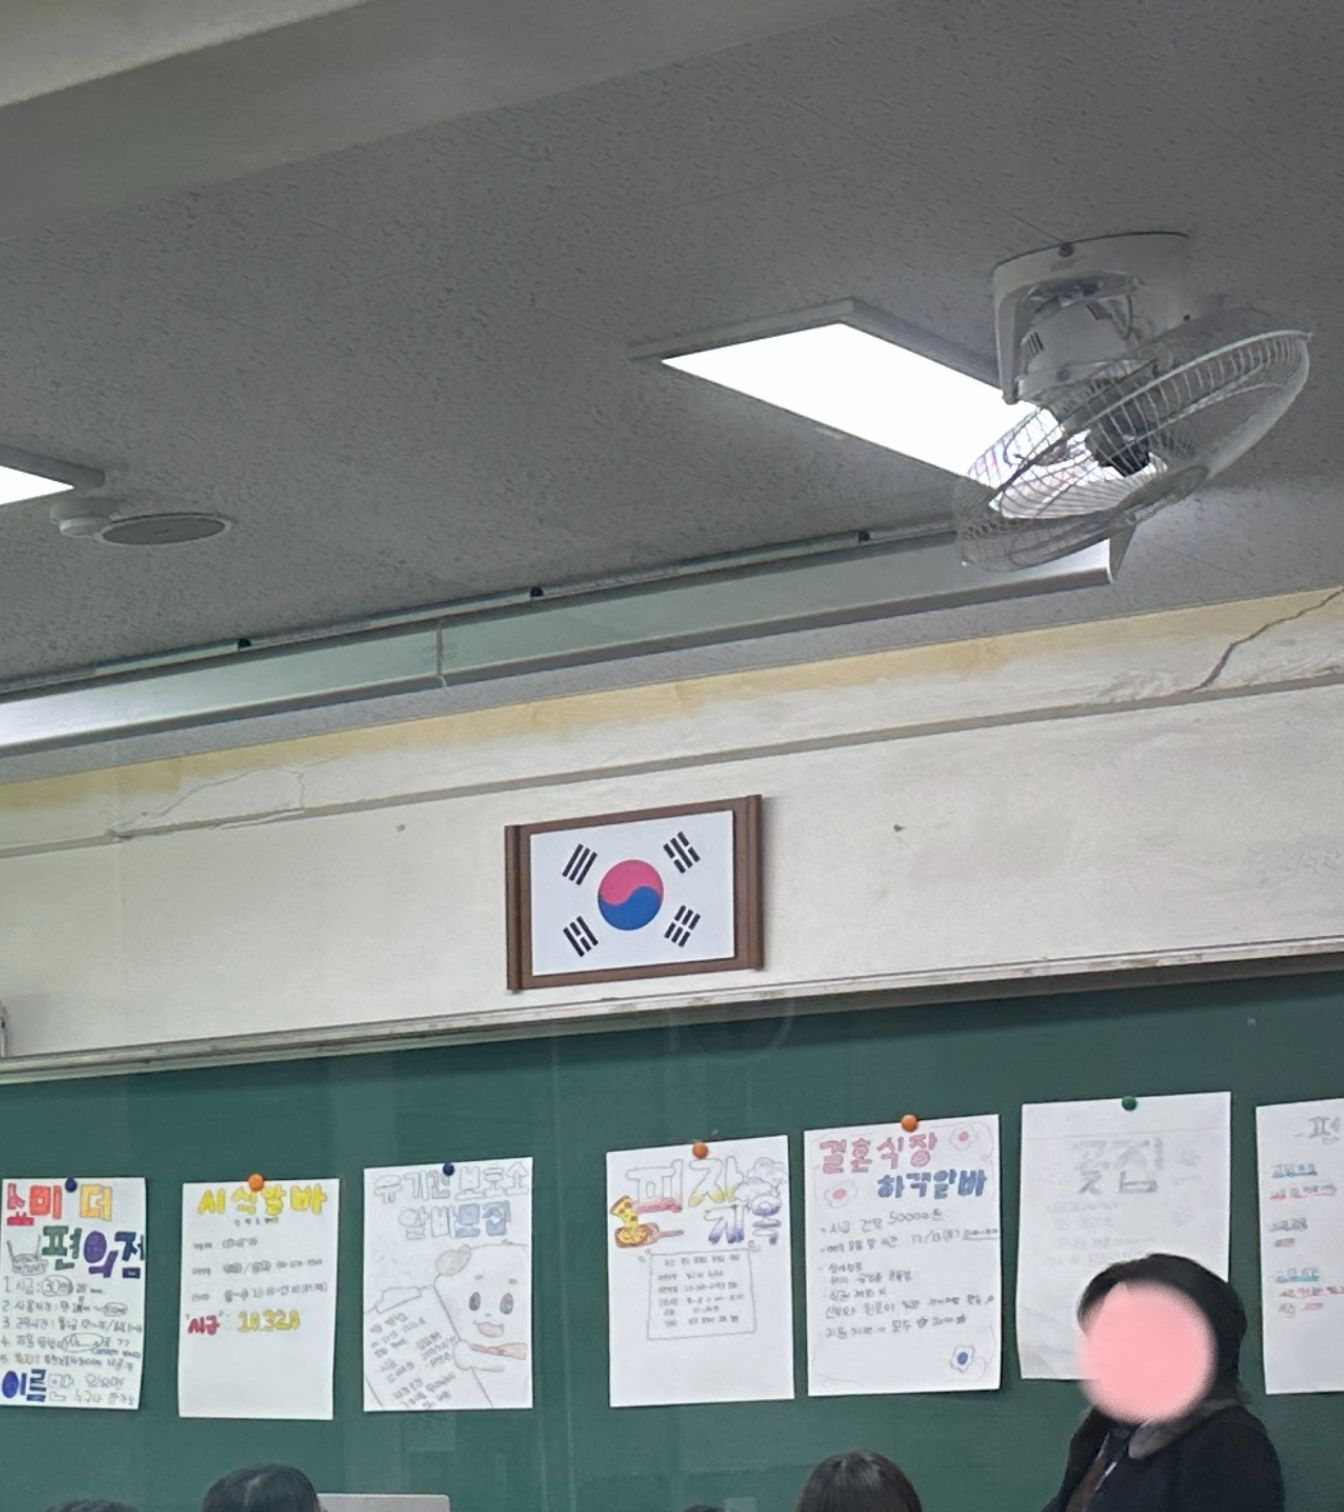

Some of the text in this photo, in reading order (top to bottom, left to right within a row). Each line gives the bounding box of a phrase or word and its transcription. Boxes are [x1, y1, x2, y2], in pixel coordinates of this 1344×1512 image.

[818, 1131, 938, 1175] 결혼식장
[372, 1161, 530, 1206] 유기견 보호소
[625, 1156, 745, 1214] 피자
[398, 1200, 512, 1240] 알바모집
[41, 1224, 145, 1279] 편의점
